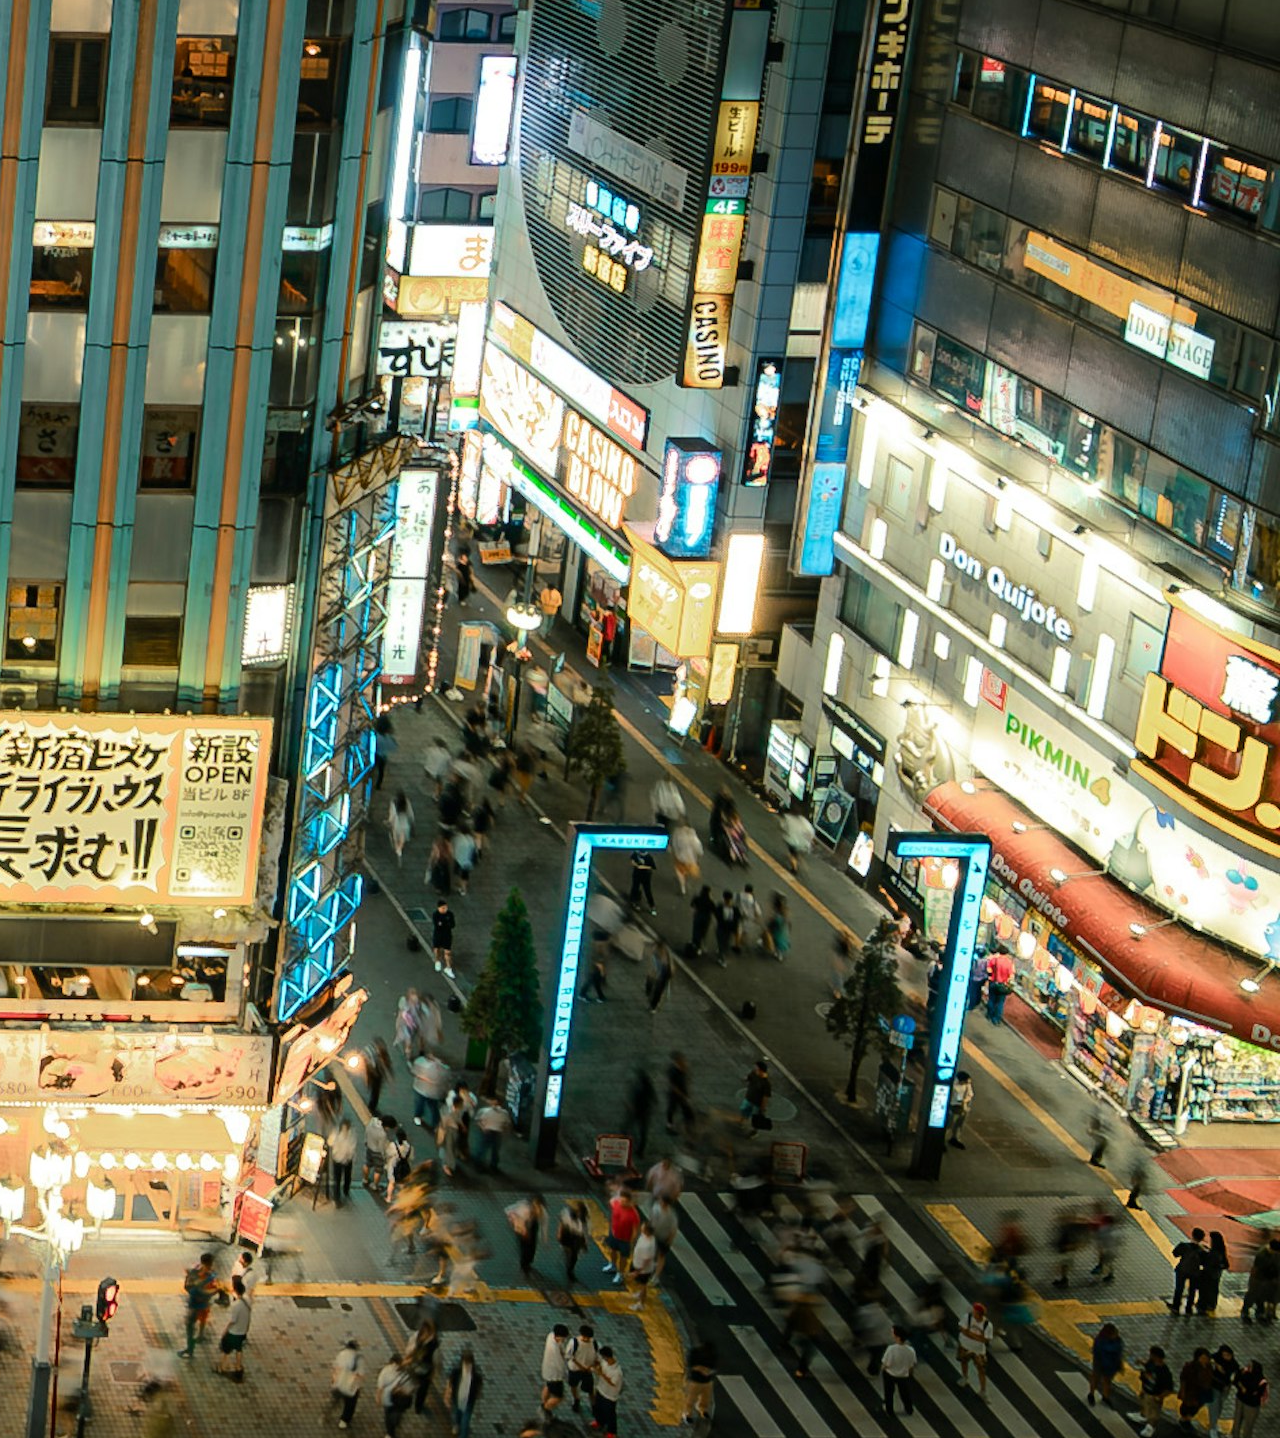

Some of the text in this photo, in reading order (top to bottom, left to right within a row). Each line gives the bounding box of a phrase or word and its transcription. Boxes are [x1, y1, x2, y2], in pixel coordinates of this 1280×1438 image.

[724, 105, 742, 159] 生ビール
[714, 161, 748, 174] 199円
[712, 200, 739, 213] 4F
[706, 218, 736, 270] 麻雀
[693, 300, 721, 382] CASINO
[1127, 311, 1212, 372] IDOL STAGE
[938, 530, 1074, 642] Don Quijote
[185, 766, 253, 785] OPEN
[187, 734, 254, 764] 新設
[1004, 712, 1089, 790] PIKMIN
[1089, 776, 1112, 807] 4
[182, 787, 251, 802] 当ビル 8F
[990, 852, 1071, 928] Don Quijote
[556, 867, 588, 1038] GODZILLA ROAD
